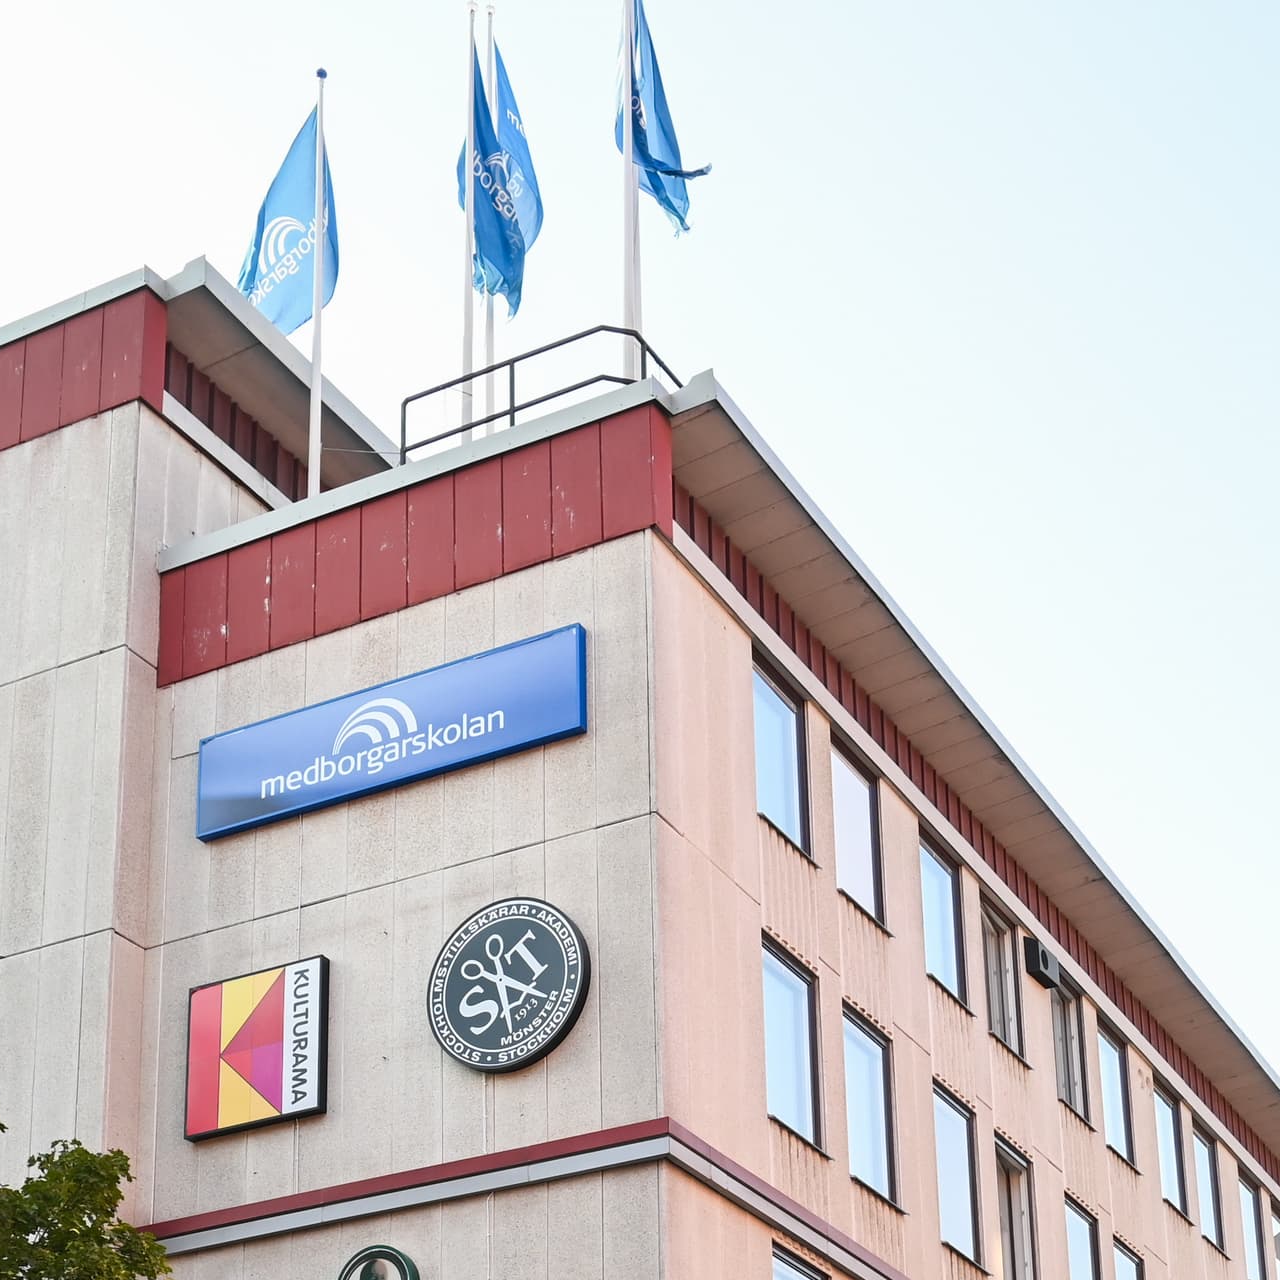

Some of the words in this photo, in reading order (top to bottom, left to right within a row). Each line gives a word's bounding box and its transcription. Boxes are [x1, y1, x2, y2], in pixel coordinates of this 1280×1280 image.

[260, 708, 505, 800] medborgarskolan
[445, 905, 530, 960] TILLSKÄRAR
[536, 910, 578, 966] AKADEMI
[291, 968, 310, 1105] KULTURAMA
[433, 966, 482, 1062] STOCKHOLMS
[497, 988, 574, 1063] STOCKHOLM
[514, 998, 539, 1022] 1913
